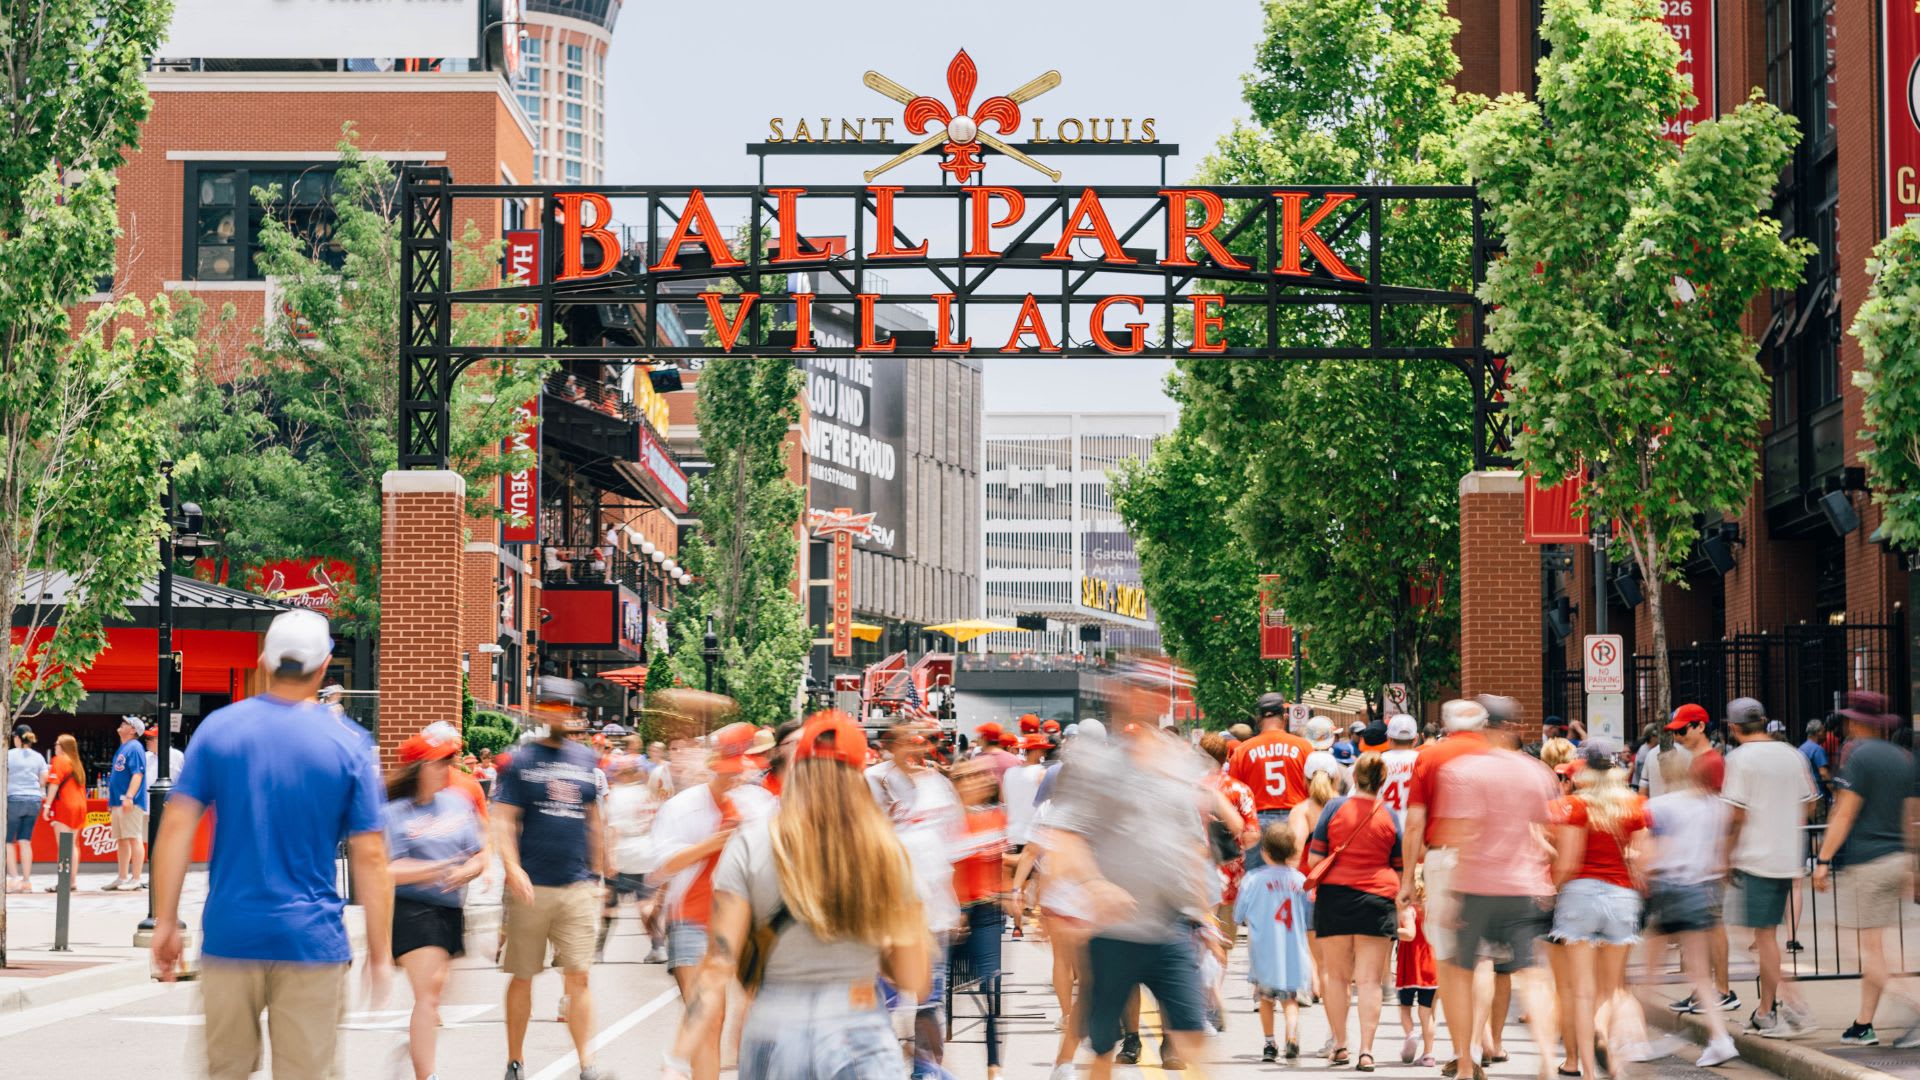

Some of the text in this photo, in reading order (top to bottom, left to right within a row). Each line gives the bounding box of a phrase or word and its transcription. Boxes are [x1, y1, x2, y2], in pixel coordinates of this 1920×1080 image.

[1660, 1, 1692, 16] 926
[768, 117, 1157, 143] SAINT LOUIS
[1660, 121, 1694, 135] 946
[552, 186, 1366, 283] BALLPARK
[698, 293, 1227, 356] VILLAGE
[808, 372, 864, 427] LOU AND
[851, 431, 895, 481] PROUD
[511, 433, 531, 528] MSEUM
[1092, 548, 1140, 560] Gatew
[1092, 563, 1124, 576] Arch
[838, 533, 848, 651] BREW HOUSE
[1082, 576, 1107, 611] SALT
[1589, 676, 1620, 684] PARKING
[1599, 668, 1609, 676] NO
[1249, 743, 1300, 763] PUJOLS
[1265, 760, 1286, 796] 5
[1275, 897, 1293, 930] 4
